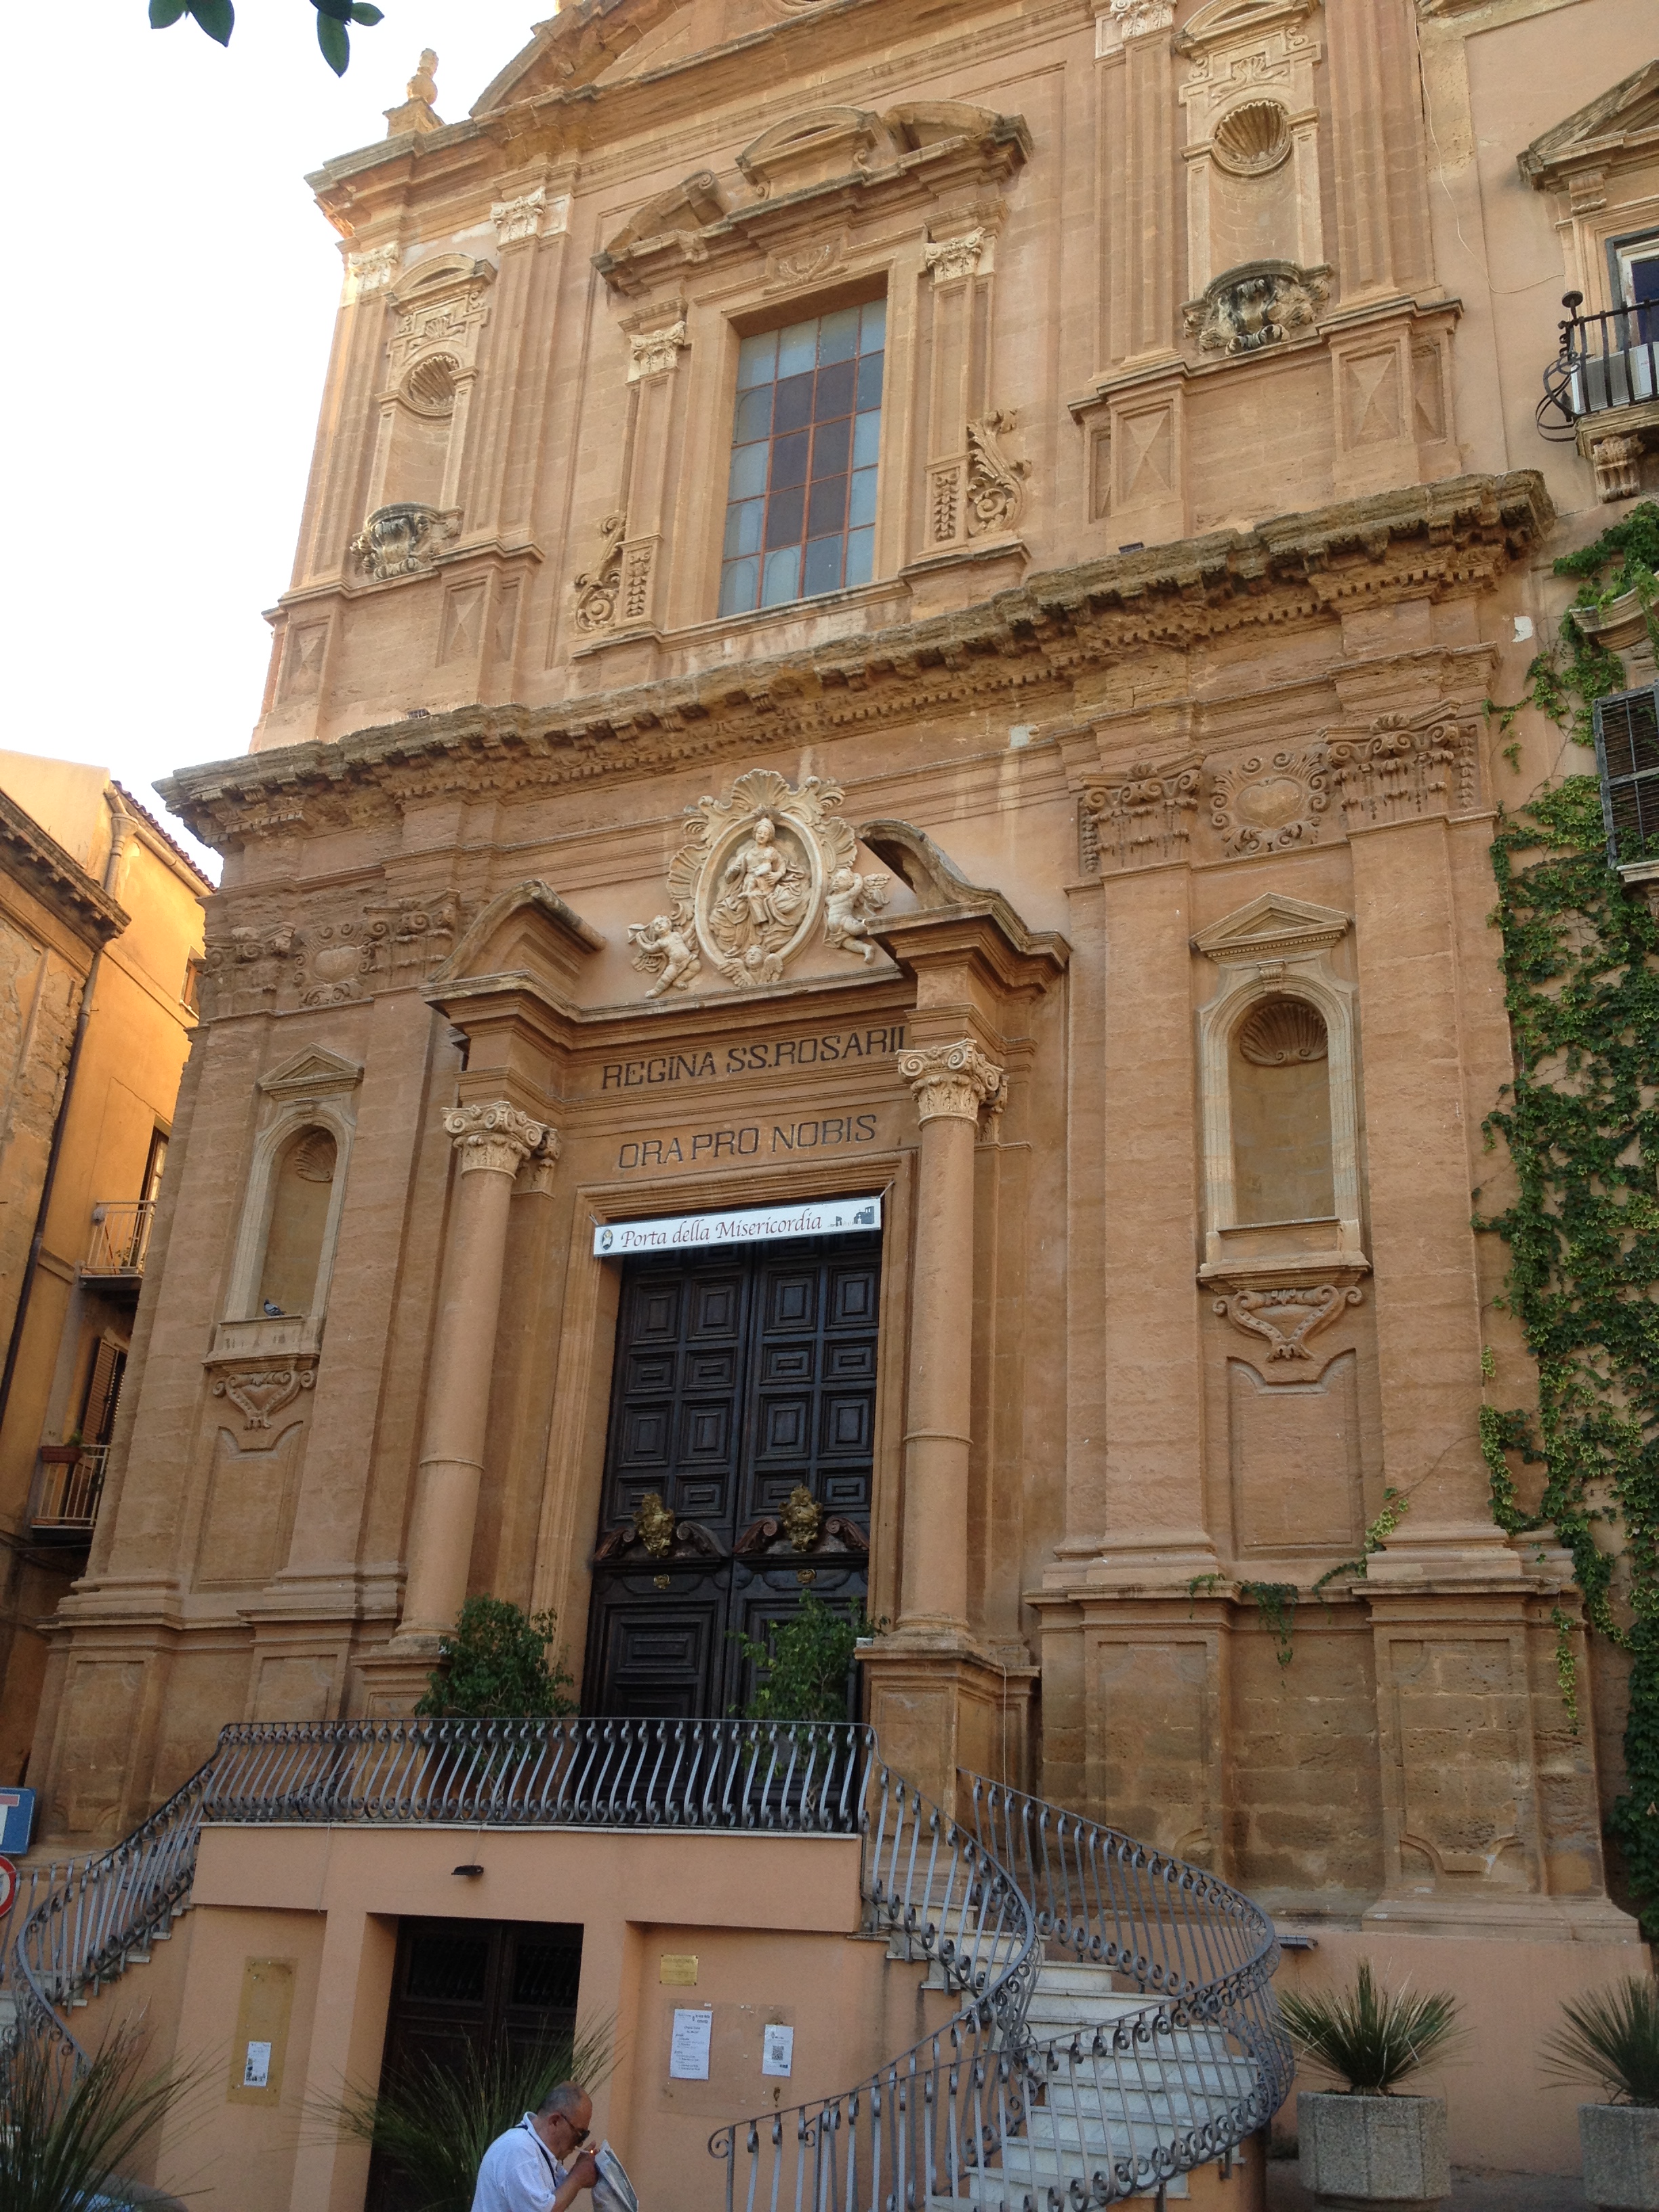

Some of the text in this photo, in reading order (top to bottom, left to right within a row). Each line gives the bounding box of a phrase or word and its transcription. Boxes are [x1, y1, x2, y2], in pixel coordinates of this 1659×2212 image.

[602, 1052, 717, 1089] REGINA
[619, 1114, 876, 1168] ORA PRO NOBIS
[621, 1208, 822, 1248] Porta della Misericordia
